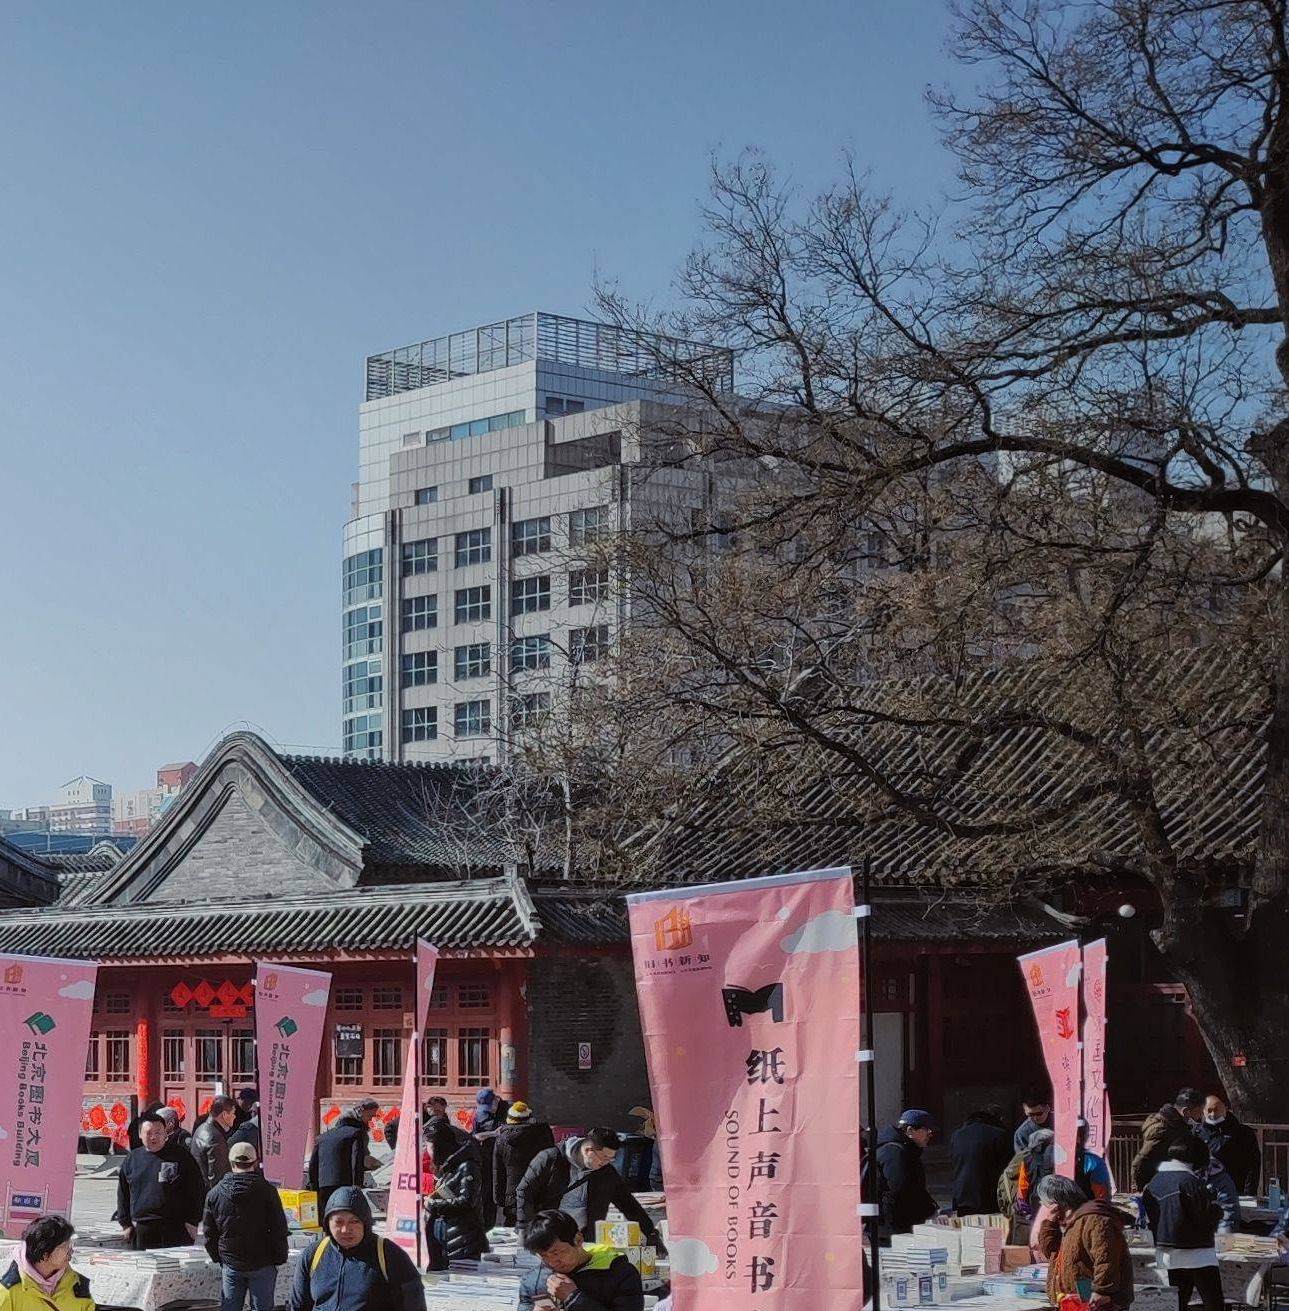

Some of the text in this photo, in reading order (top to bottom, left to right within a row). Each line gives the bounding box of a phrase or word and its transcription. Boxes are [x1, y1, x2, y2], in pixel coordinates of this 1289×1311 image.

[12, 1041, 31, 1167] Beijing Books Building
[725, 1110, 740, 1281] SOUND OF BOOKS
